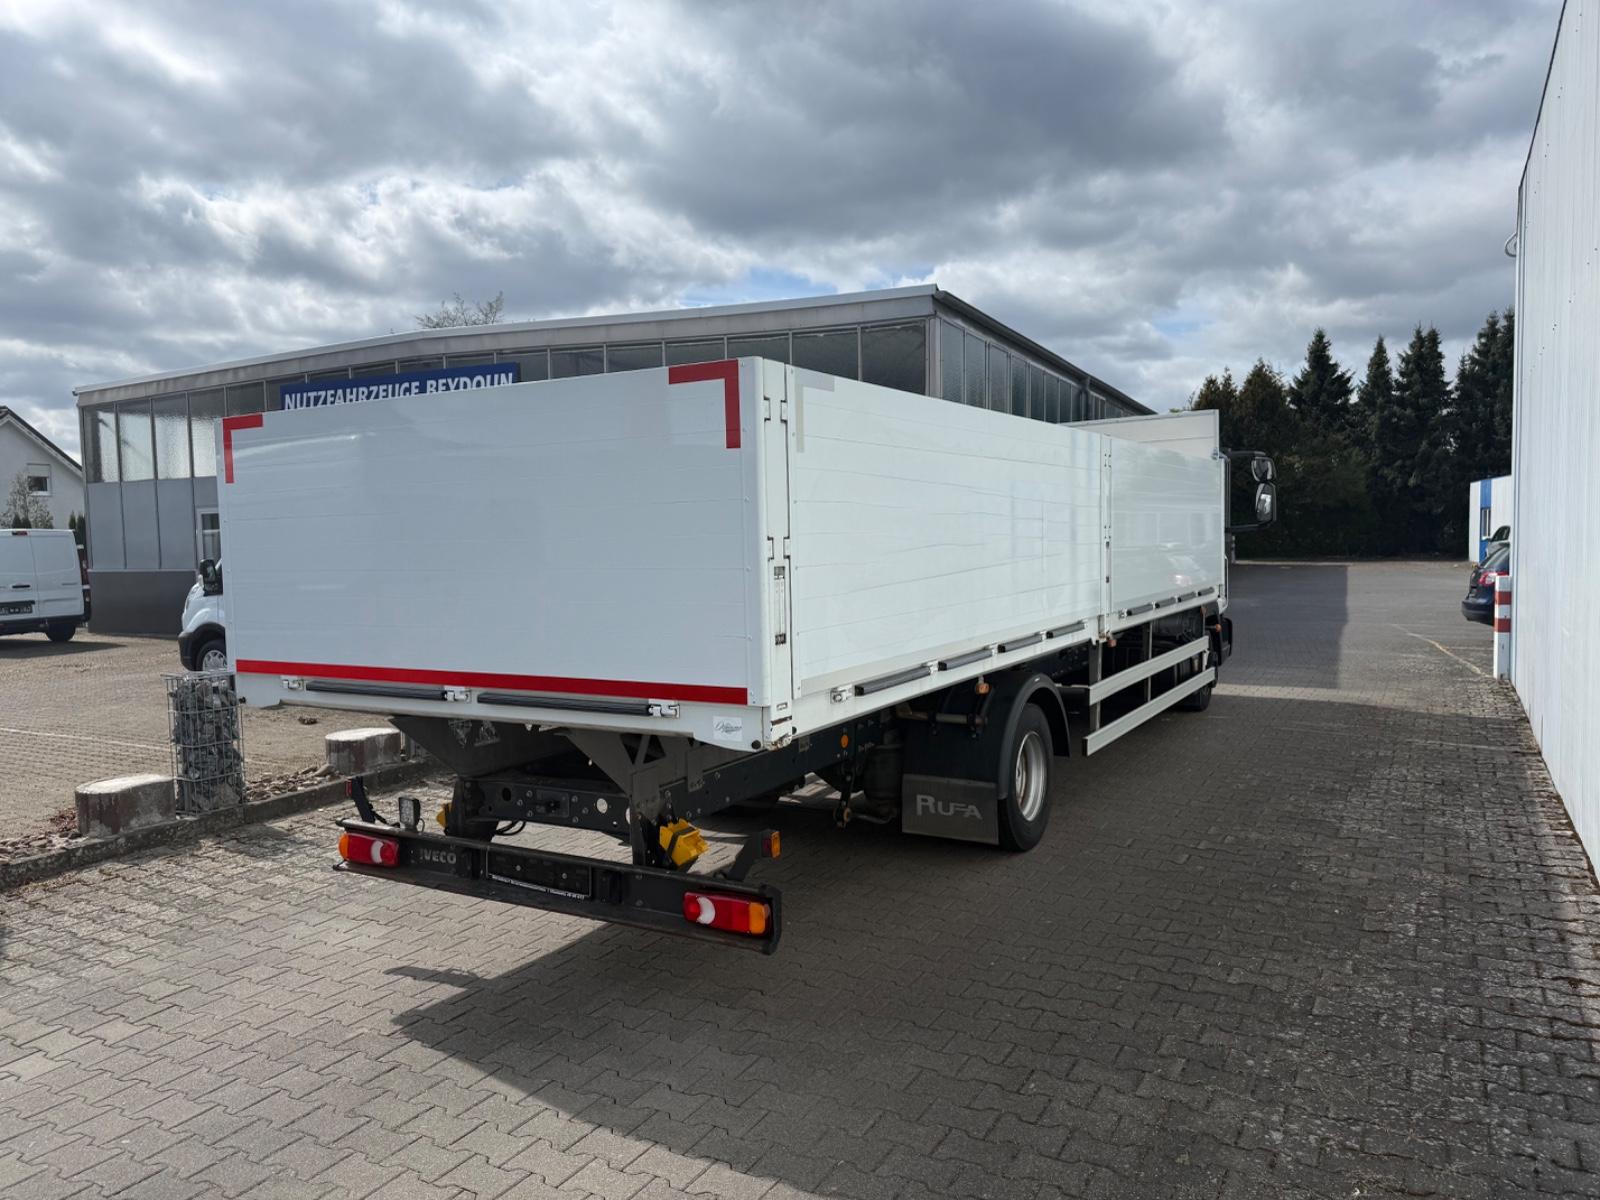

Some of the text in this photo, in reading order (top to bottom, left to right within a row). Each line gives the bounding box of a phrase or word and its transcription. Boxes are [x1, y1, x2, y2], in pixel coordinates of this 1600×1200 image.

[284, 372, 513, 411] NUTZFAHRZEUGE BEYDOUN
[916, 794, 984, 820] RUFA
[418, 847, 457, 865] IVECO
